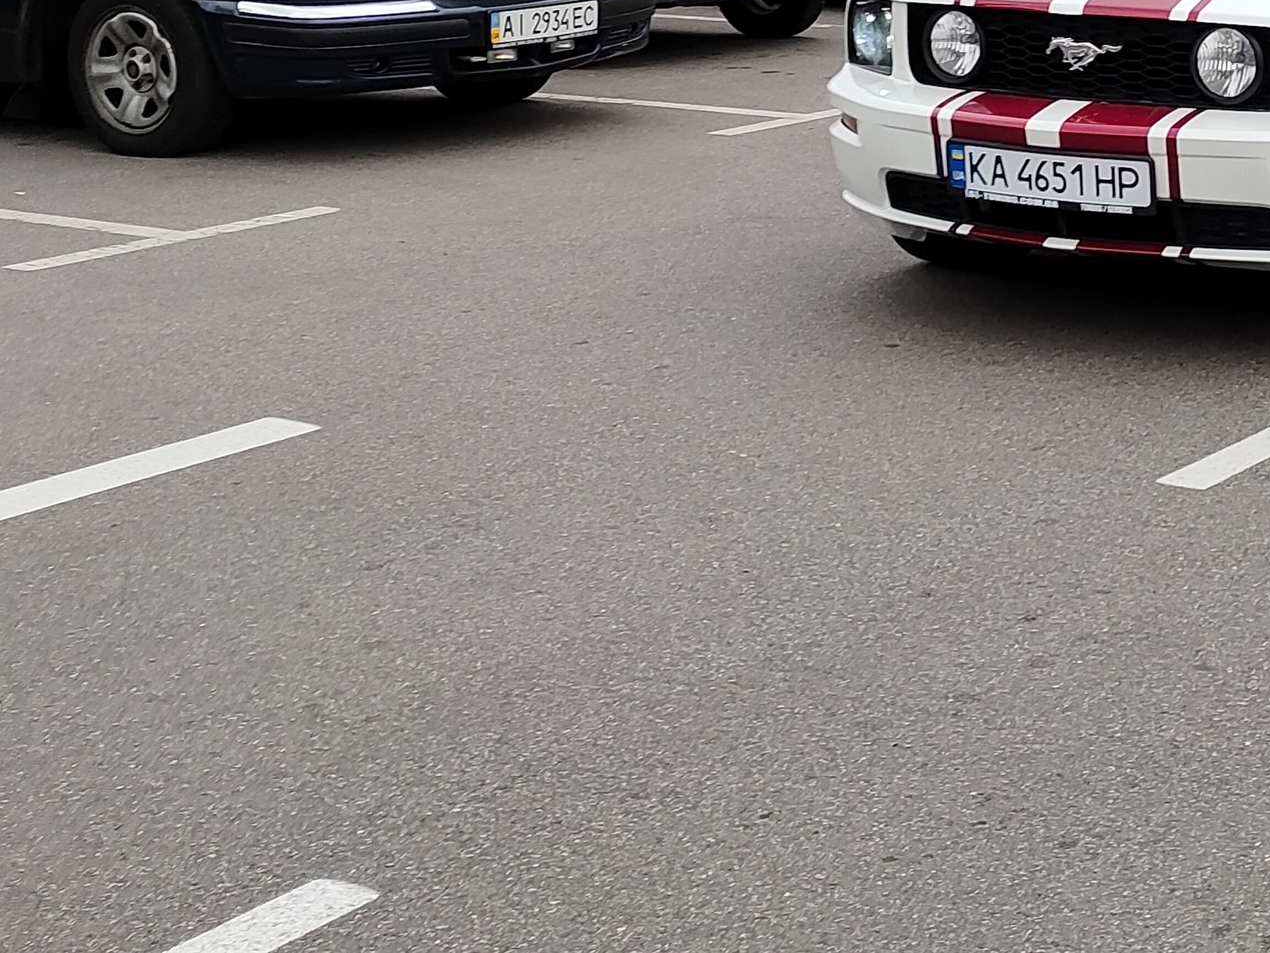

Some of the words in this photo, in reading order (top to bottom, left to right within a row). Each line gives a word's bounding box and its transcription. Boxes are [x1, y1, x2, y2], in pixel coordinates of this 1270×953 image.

[503, 14, 524, 38] AI
[532, 8, 569, 35] 2934
[572, 5, 594, 29] EC
[969, 151, 1009, 188] KA
[1017, 159, 1084, 196] 4651
[1094, 165, 1139, 199] HP
